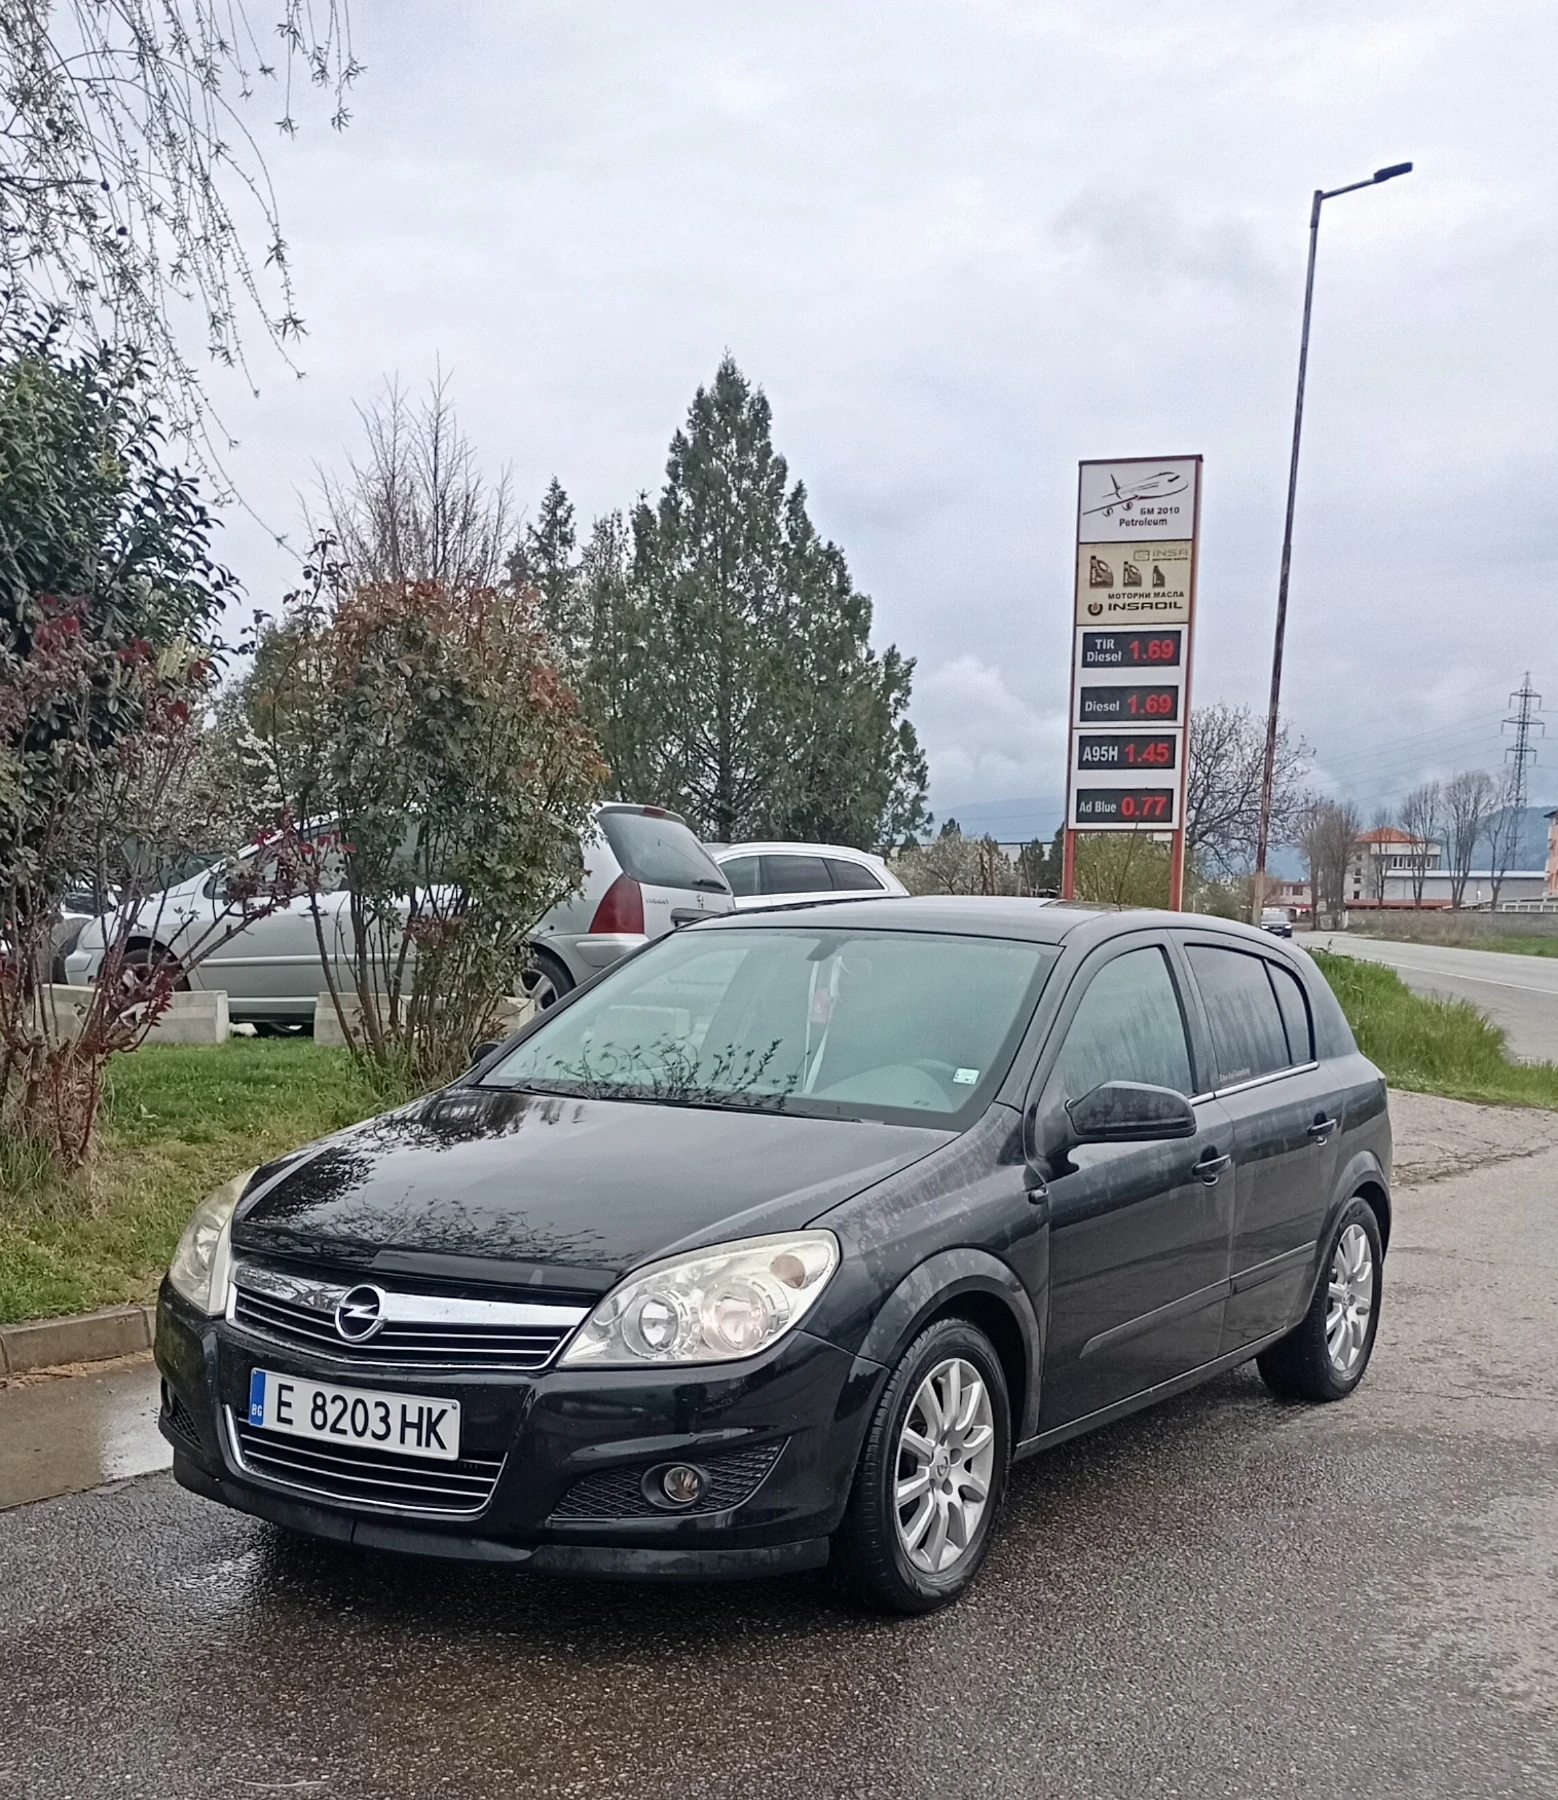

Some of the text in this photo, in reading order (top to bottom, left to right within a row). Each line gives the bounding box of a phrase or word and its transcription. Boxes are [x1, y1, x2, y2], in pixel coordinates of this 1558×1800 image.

[1157, 507, 1180, 515] 2010
[1119, 518, 1168, 527] Petroleum
[1152, 549, 1188, 557] INSA
[1086, 640, 1175, 662] Diesel 1.69
[1095, 639, 1114, 649] TIR
[1085, 695, 1172, 714] Diesel 1.69
[1082, 743, 1169, 762] A95H 1.45
[1079, 797, 1167, 816] Ad Blue 0.77
[251, 1403, 263, 1417] BG
[276, 1383, 448, 1450] E 8203 HK
